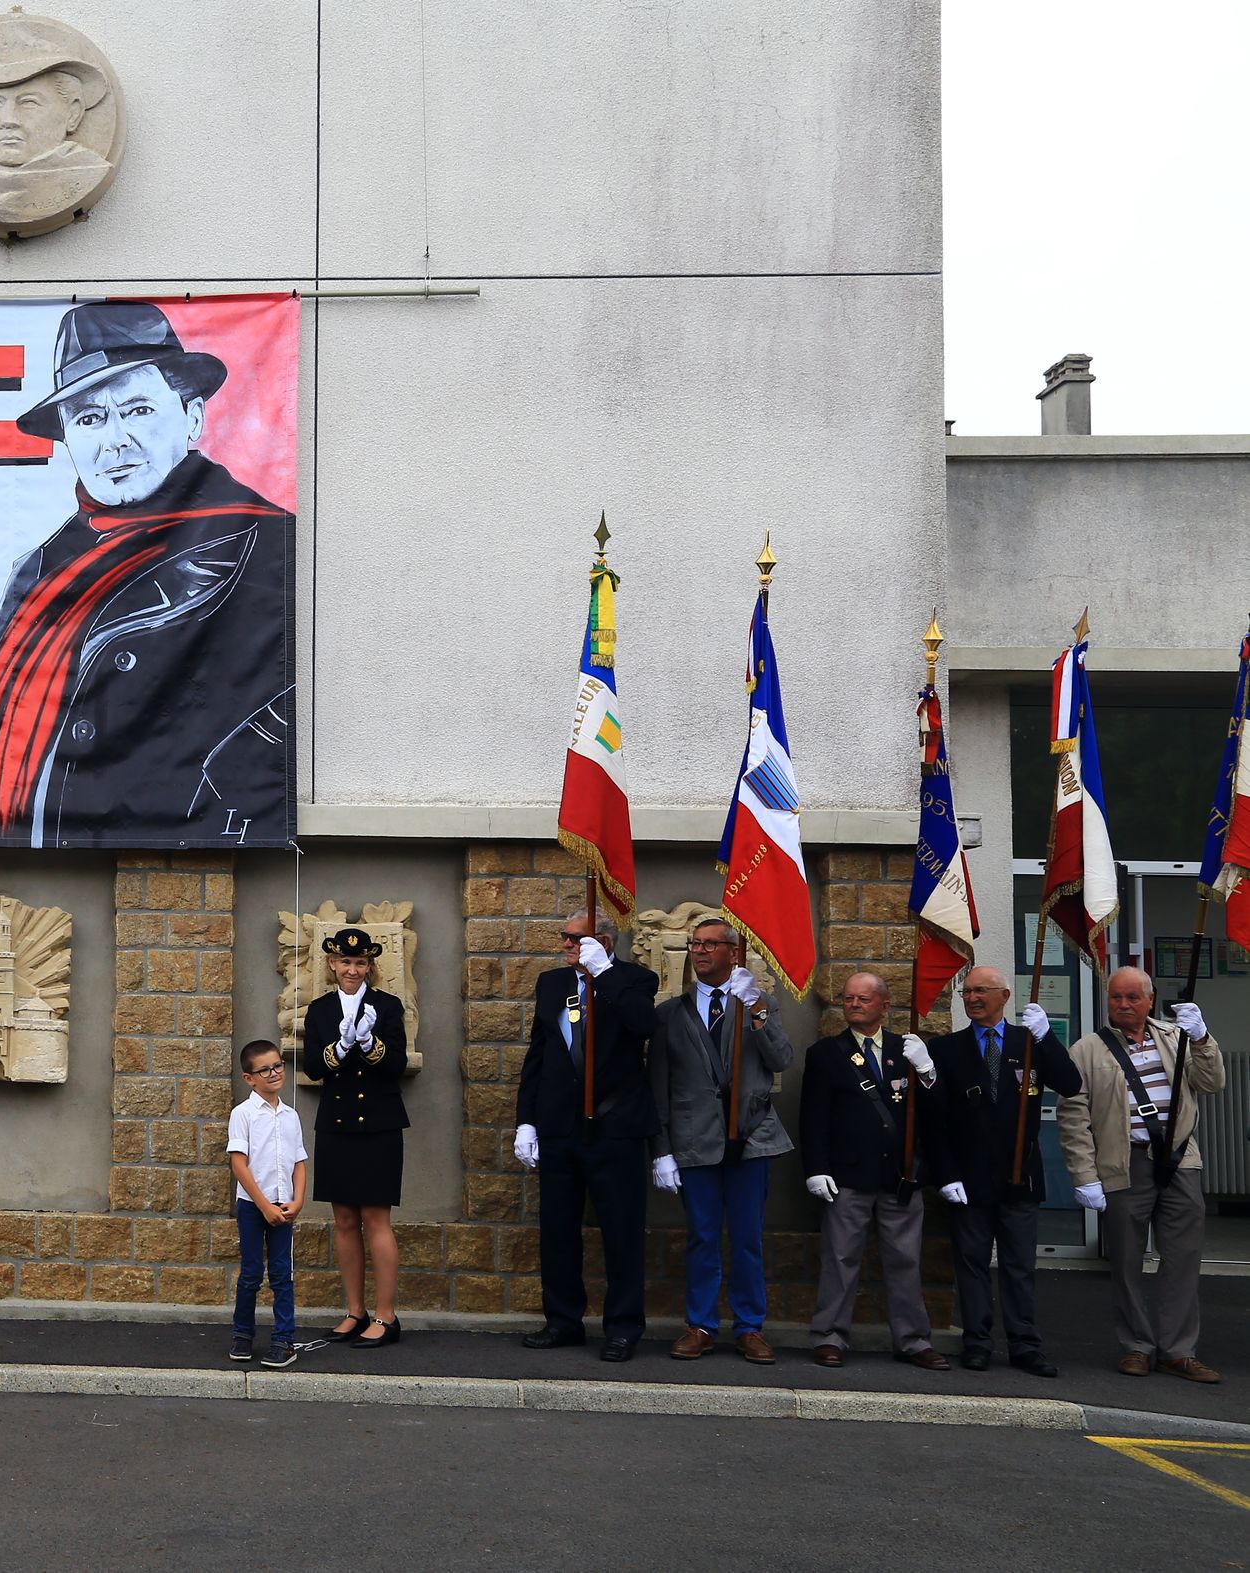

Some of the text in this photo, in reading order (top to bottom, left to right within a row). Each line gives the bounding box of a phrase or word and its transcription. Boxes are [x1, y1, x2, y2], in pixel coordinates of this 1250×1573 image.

[570, 678, 605, 748] VALEUR
[725, 872, 749, 899] 1914
[751, 843, 768, 869] 1918
